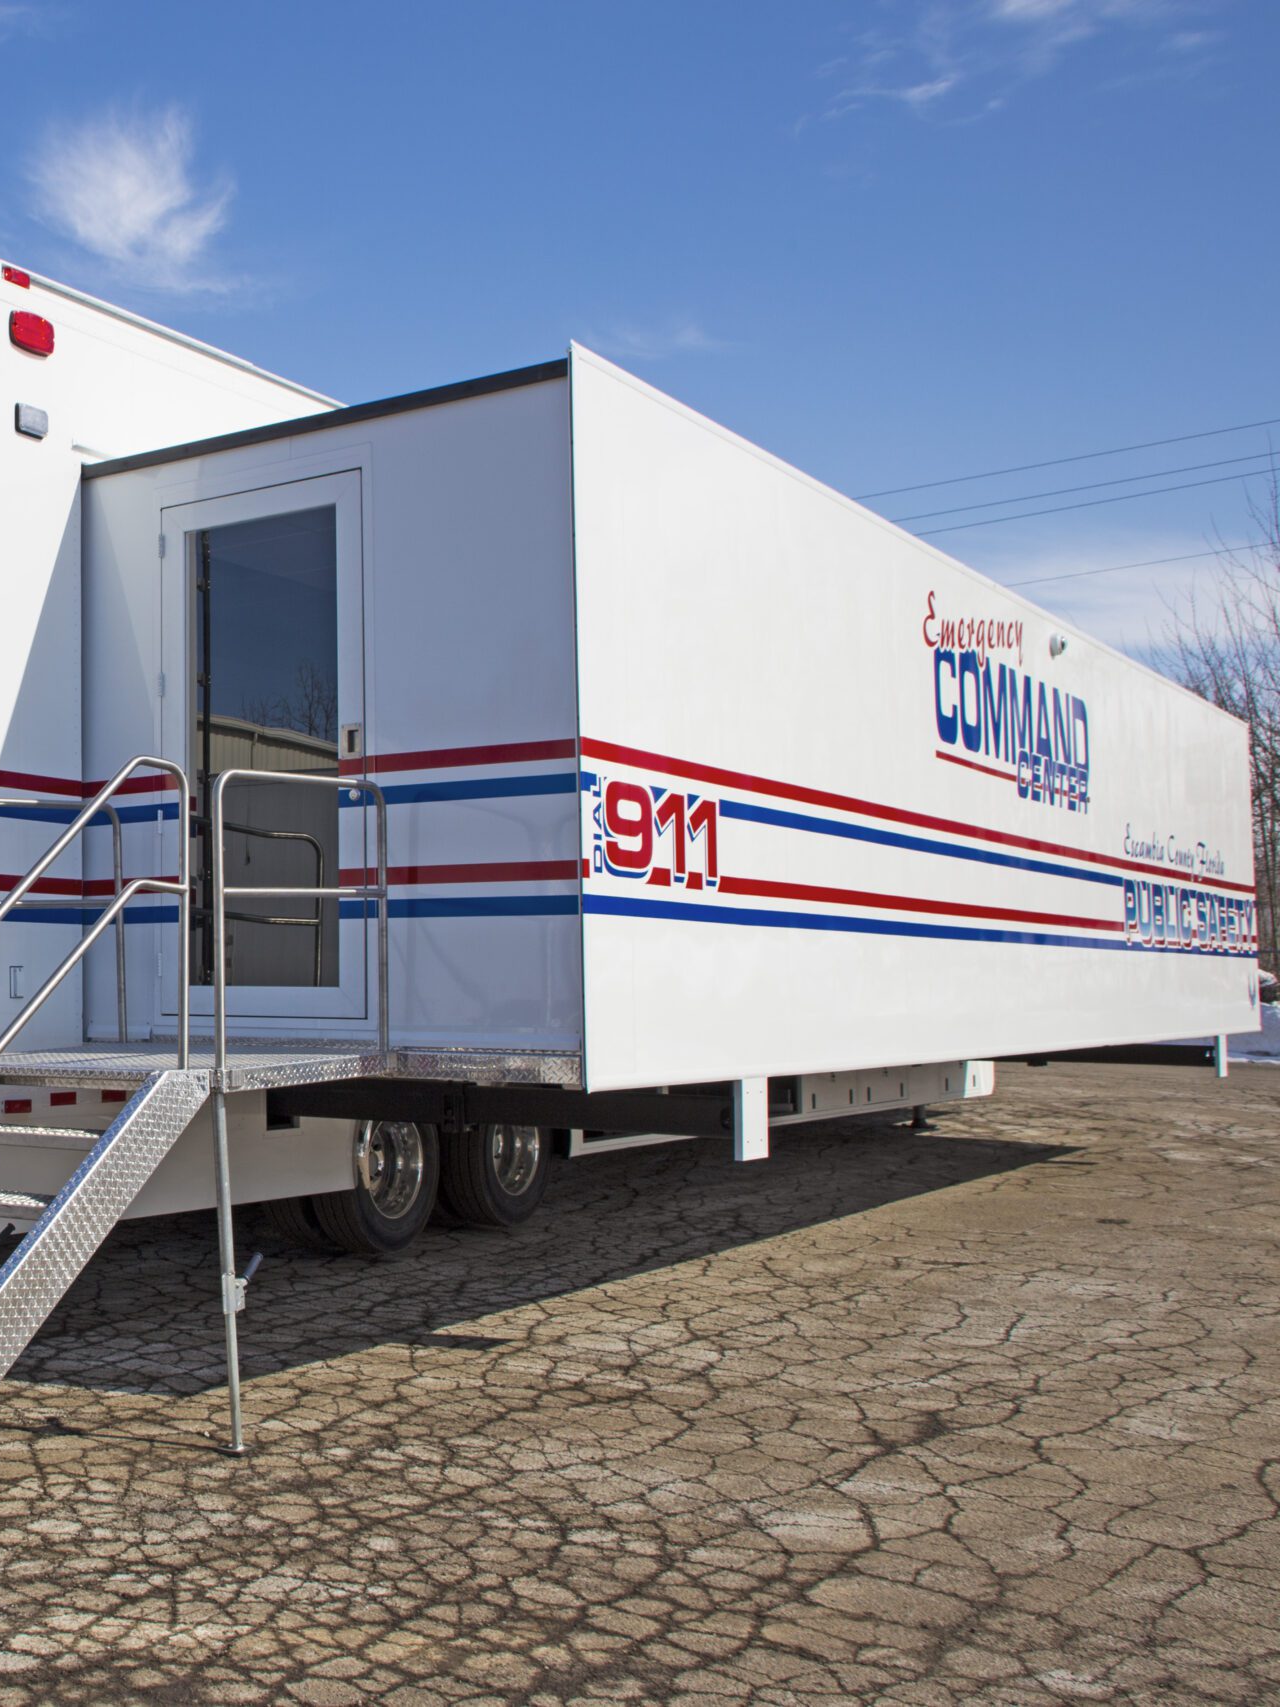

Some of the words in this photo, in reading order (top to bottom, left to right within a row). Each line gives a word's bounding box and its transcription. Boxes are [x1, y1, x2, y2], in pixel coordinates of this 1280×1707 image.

[923, 590, 1024, 667] Emergency
[933, 646, 1089, 770] COMMAND
[593, 777, 602, 873] DIAL
[1017, 750, 1089, 814] CENTER
[603, 780, 719, 887] 911
[1124, 879, 1193, 948] PUBLIC
[1195, 890, 1254, 954] SAFETY
